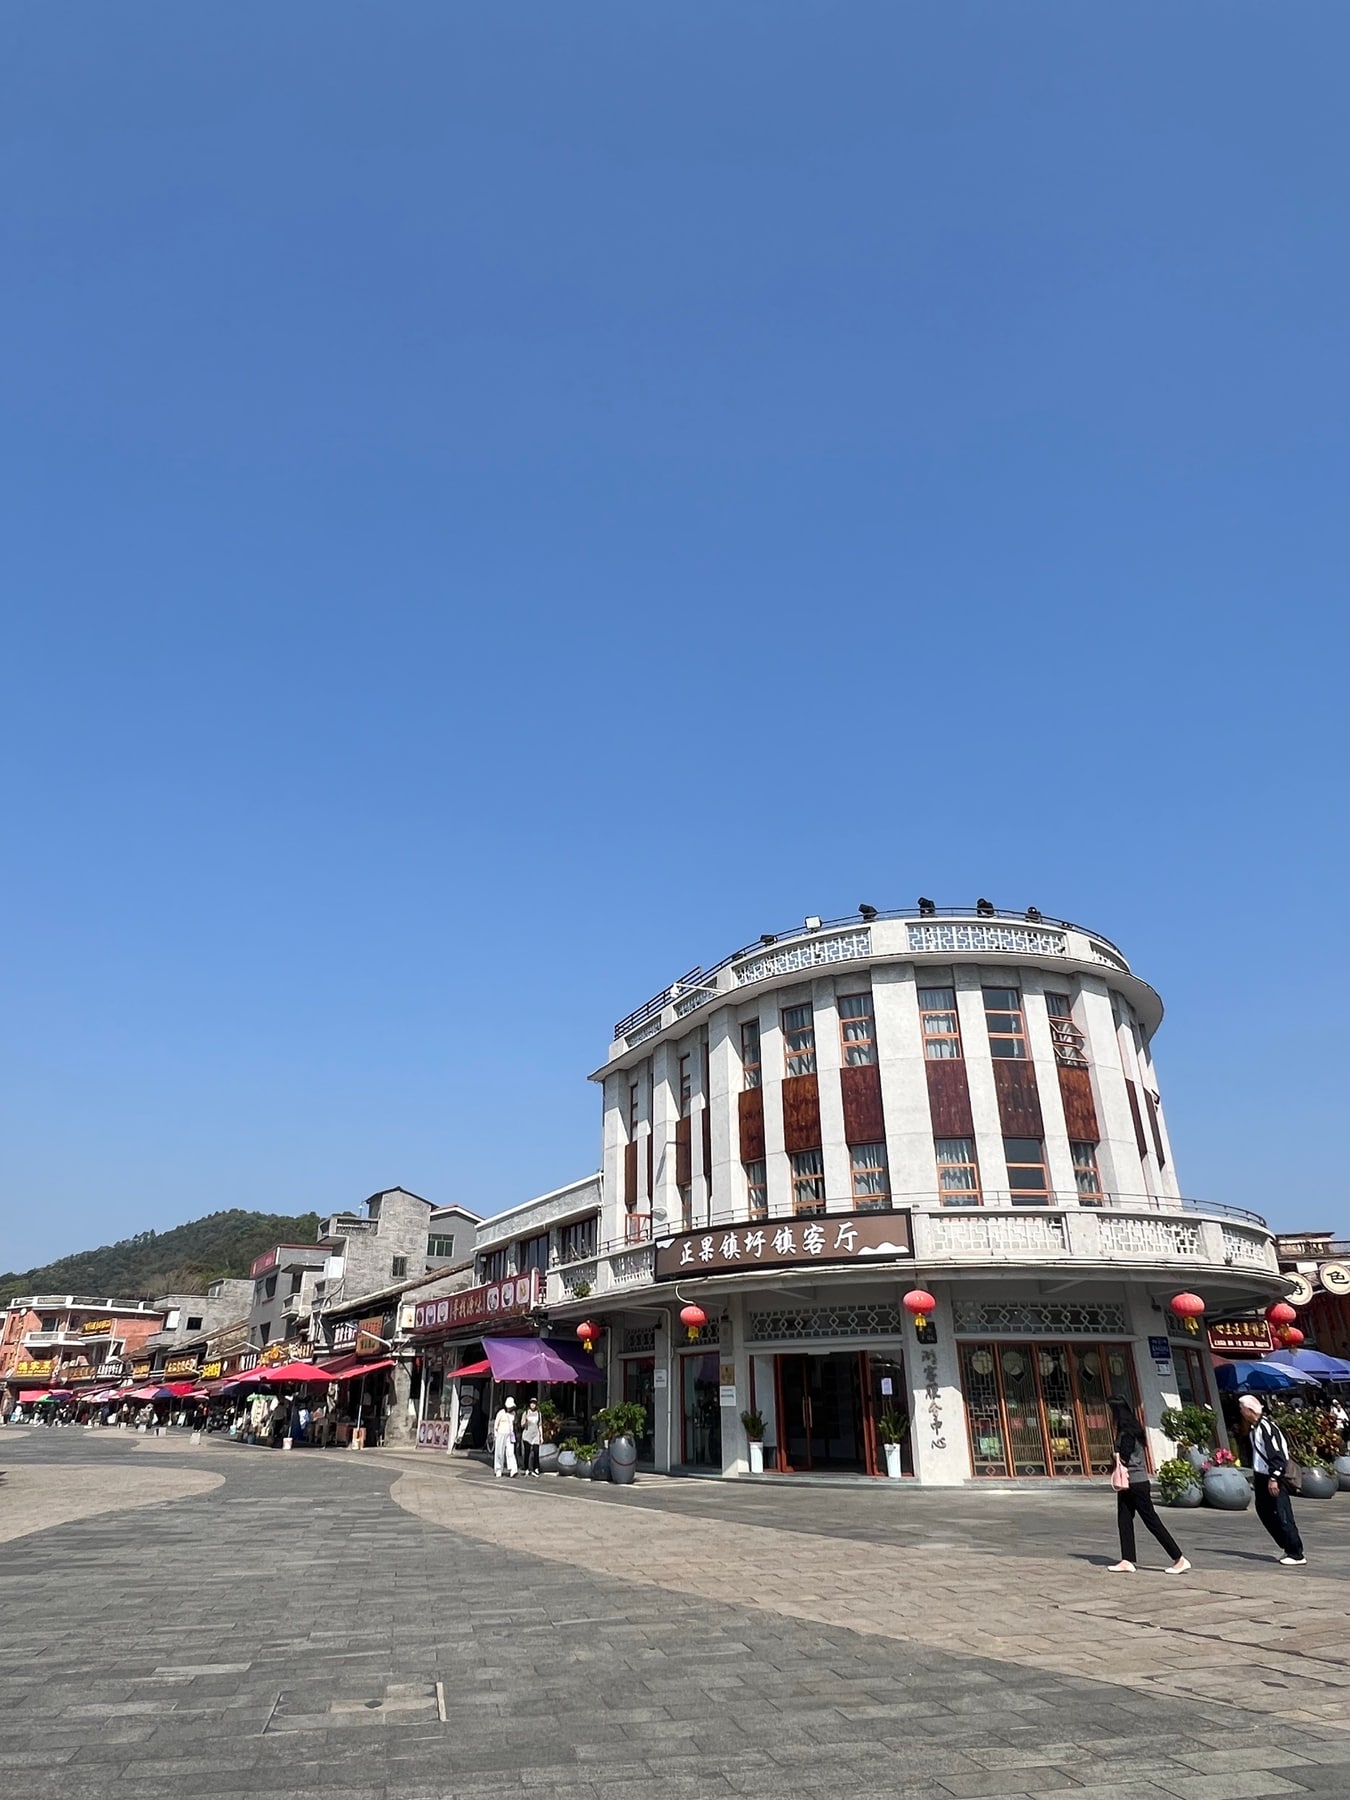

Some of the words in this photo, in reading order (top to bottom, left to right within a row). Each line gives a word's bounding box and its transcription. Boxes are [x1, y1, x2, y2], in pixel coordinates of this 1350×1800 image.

[679, 1221, 859, 1266] 正果镇圩镇客厅
